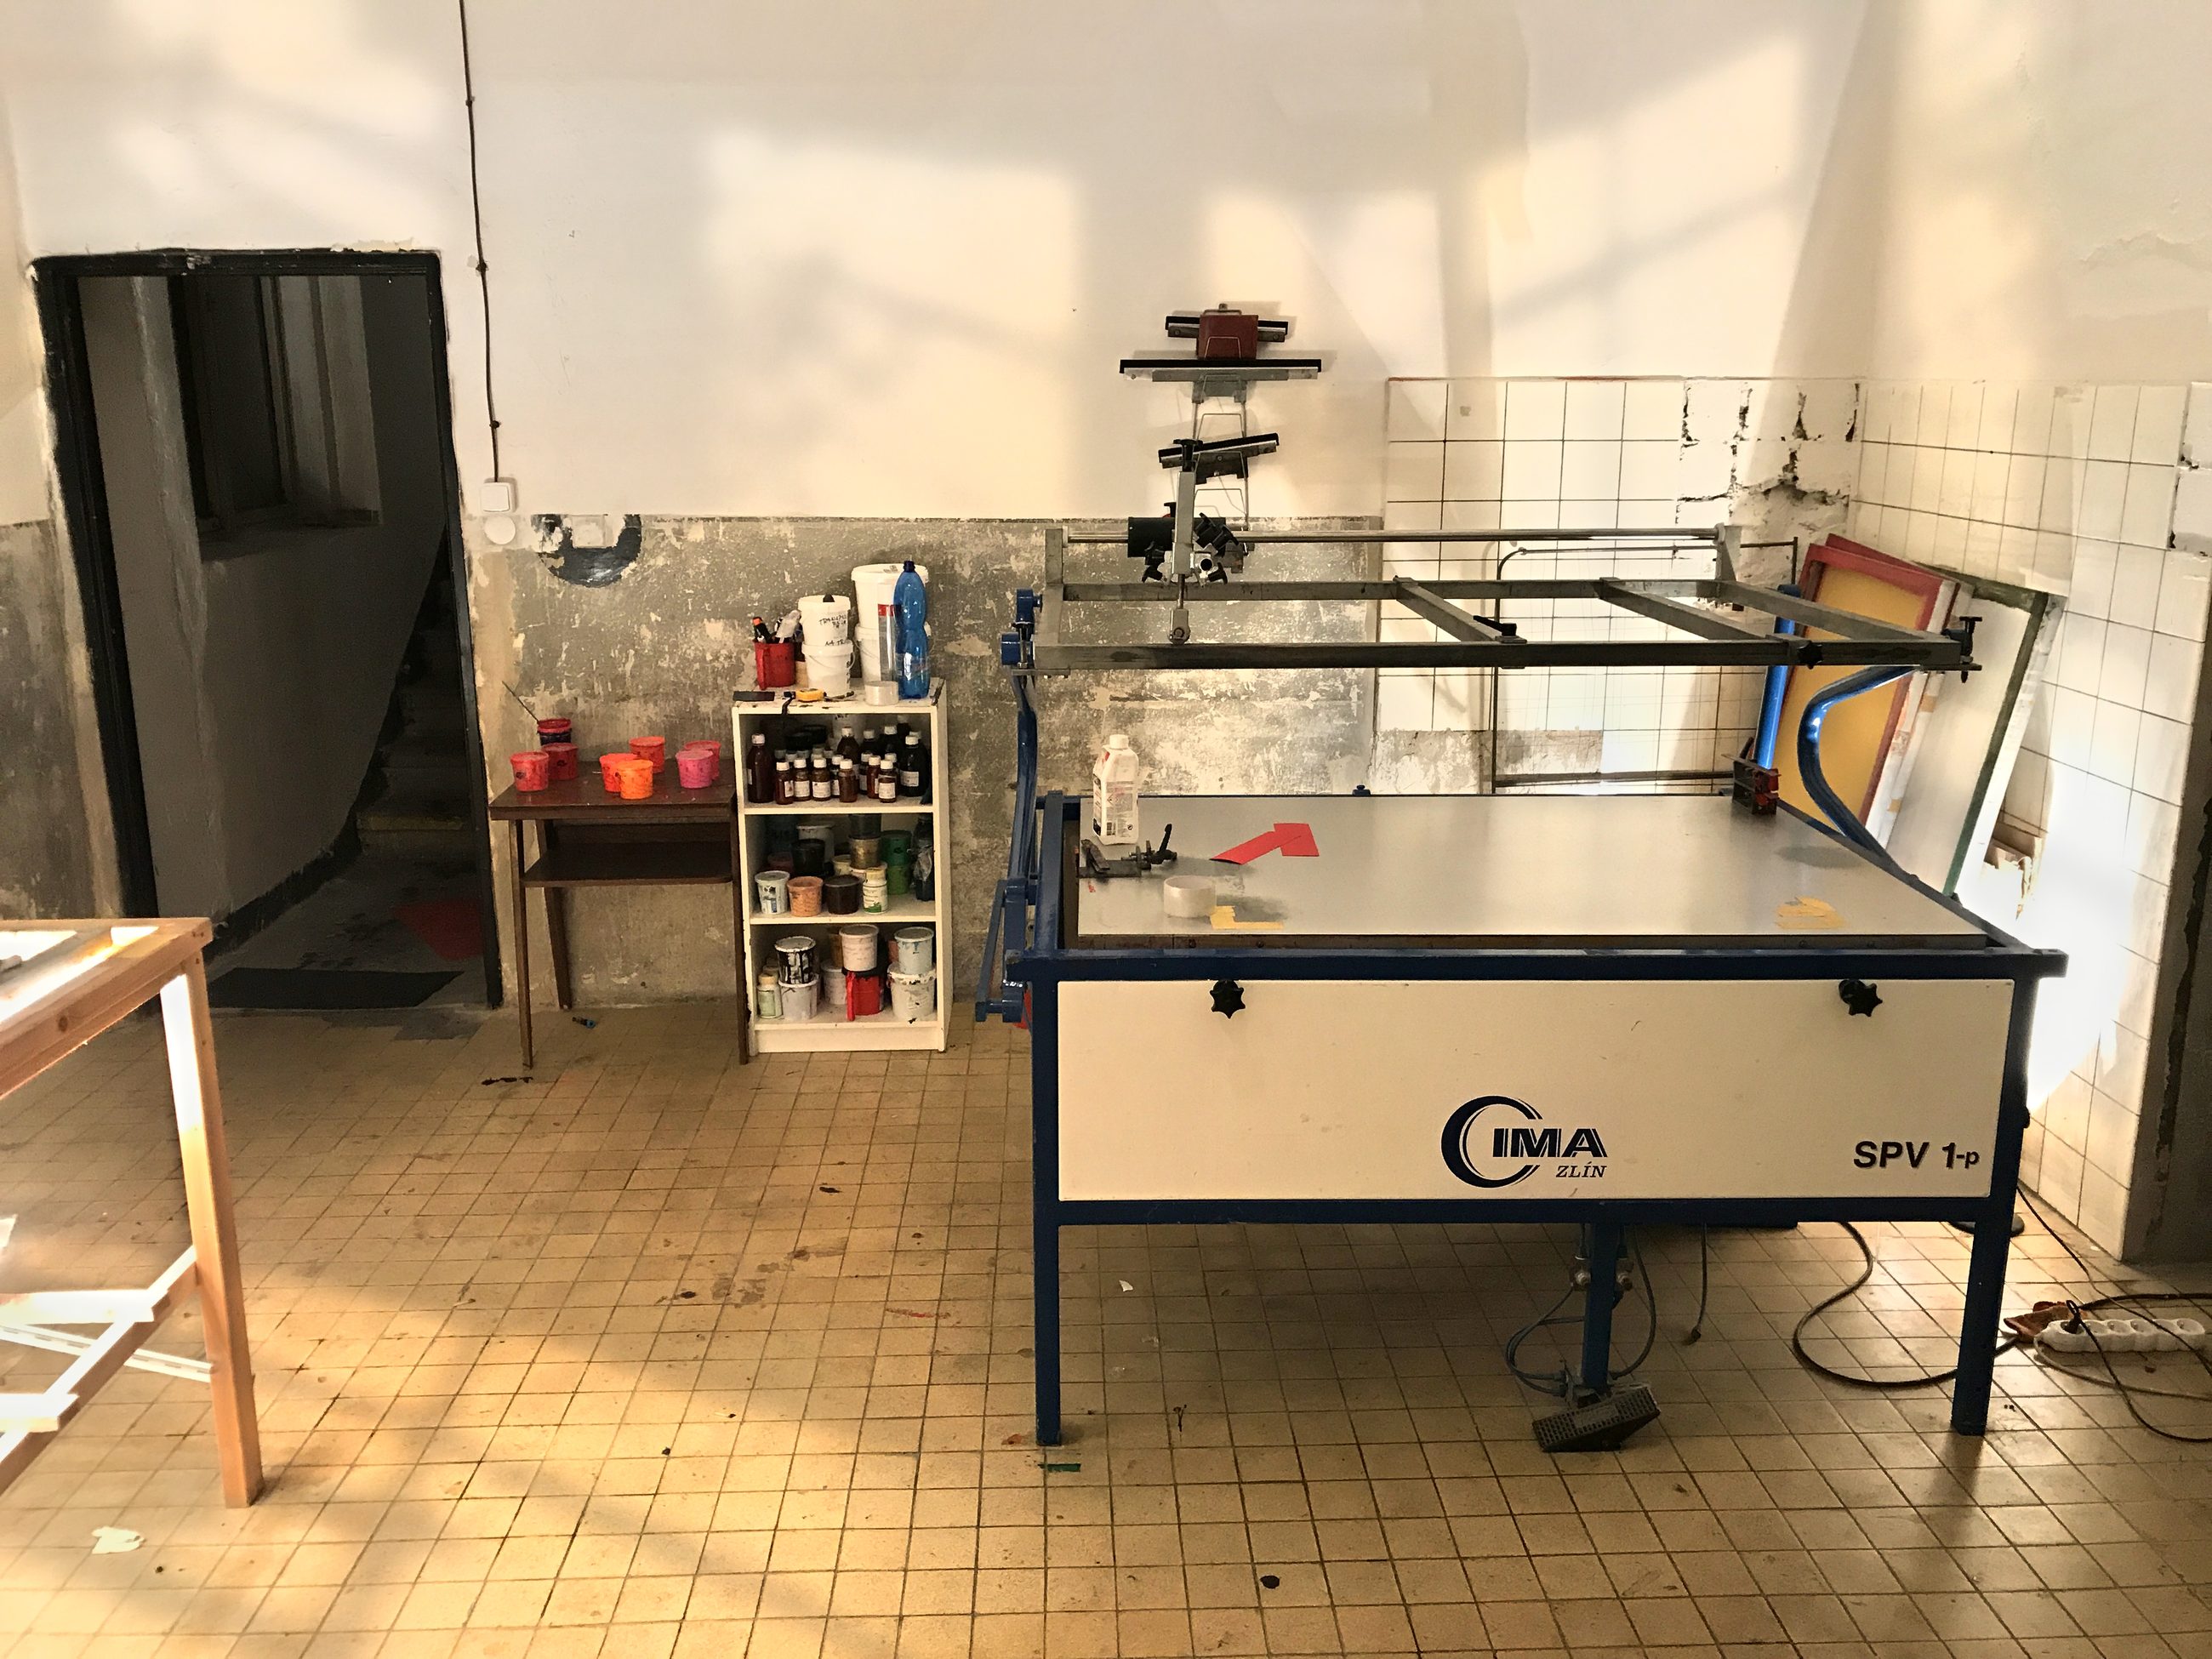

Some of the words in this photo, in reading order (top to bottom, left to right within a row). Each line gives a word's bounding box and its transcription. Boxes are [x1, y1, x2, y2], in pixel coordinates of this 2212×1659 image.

[1441, 1095, 1608, 1189] CIMA
[1853, 1140, 1930, 1169] SPV
[1555, 1160, 1607, 1177] ZLÍN
